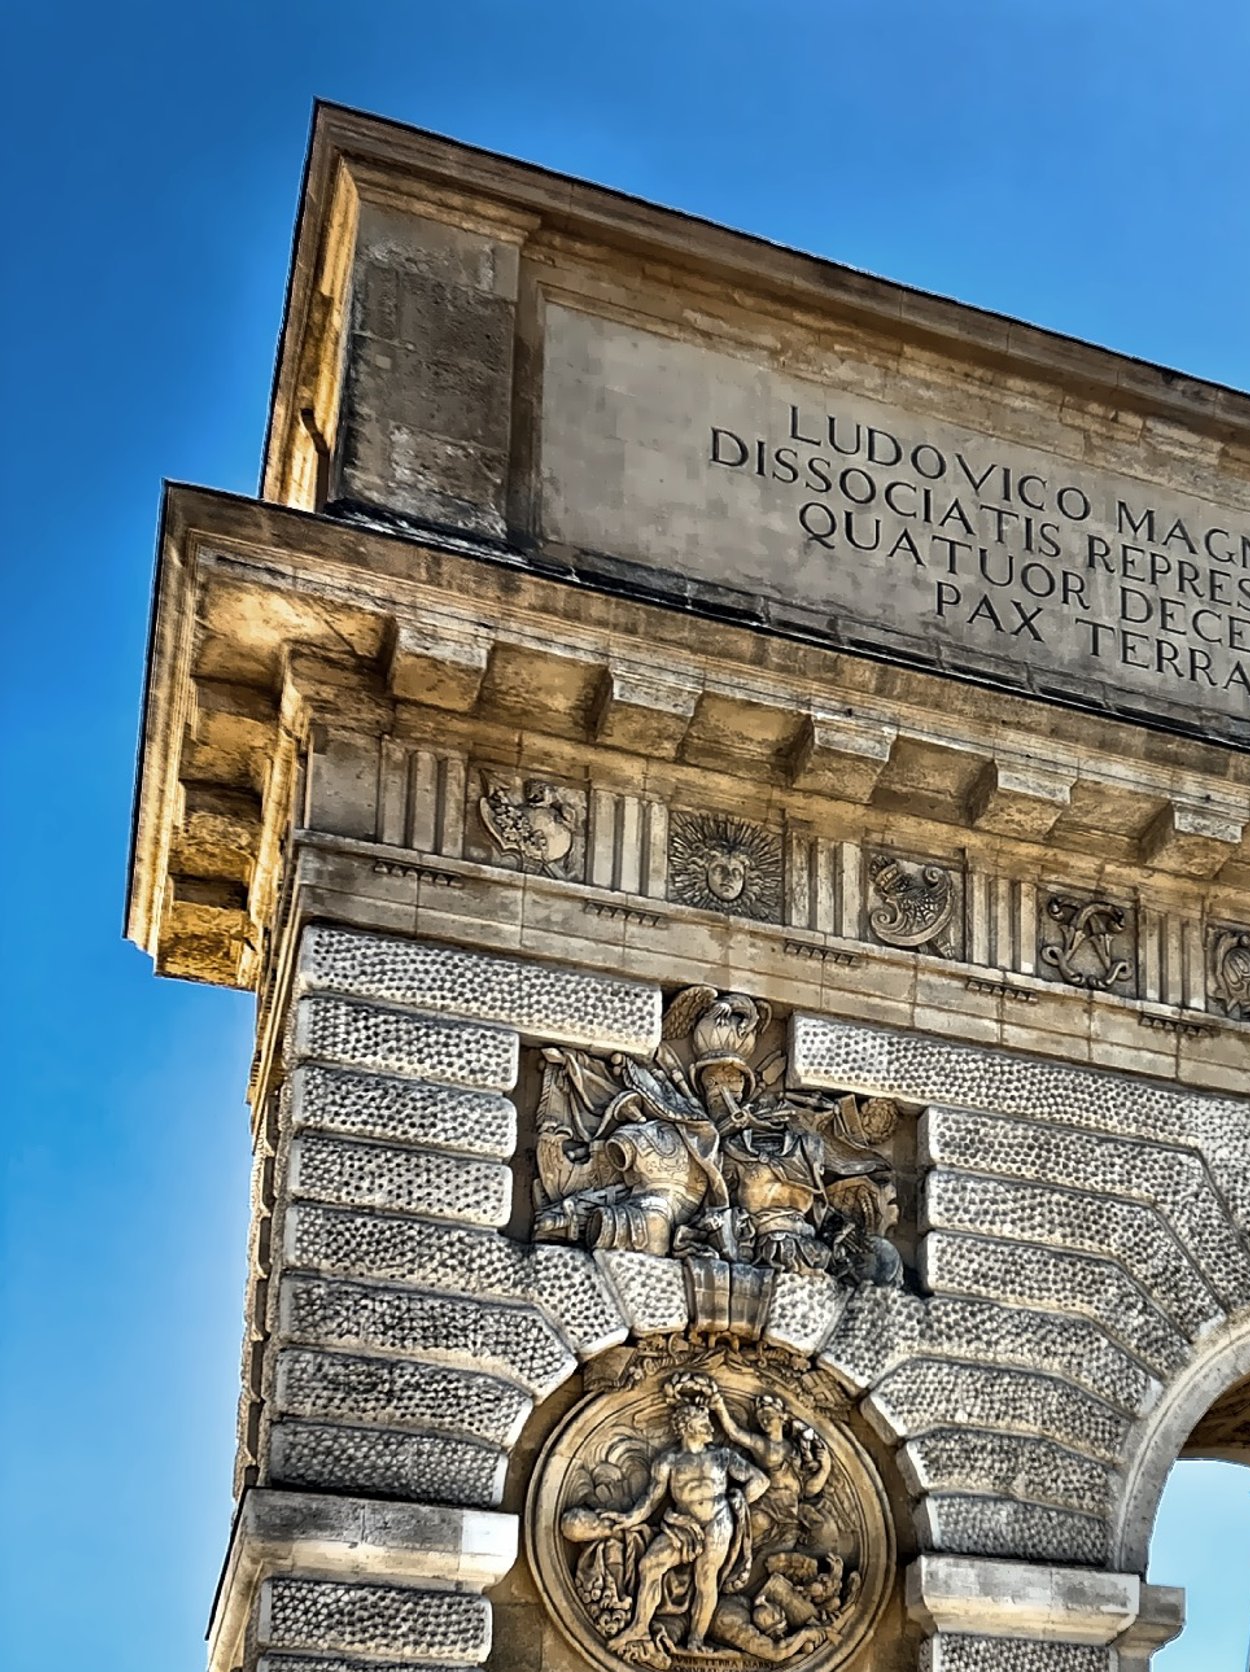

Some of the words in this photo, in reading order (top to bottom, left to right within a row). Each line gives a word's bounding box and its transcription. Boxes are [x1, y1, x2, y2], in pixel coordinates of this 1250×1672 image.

[709, 426, 1061, 558] DISSOCIATIS
[789, 405, 1090, 521] LUDOVICO
[799, 502, 1090, 610] QUATUOR
[936, 580, 1044, 643] PAX
